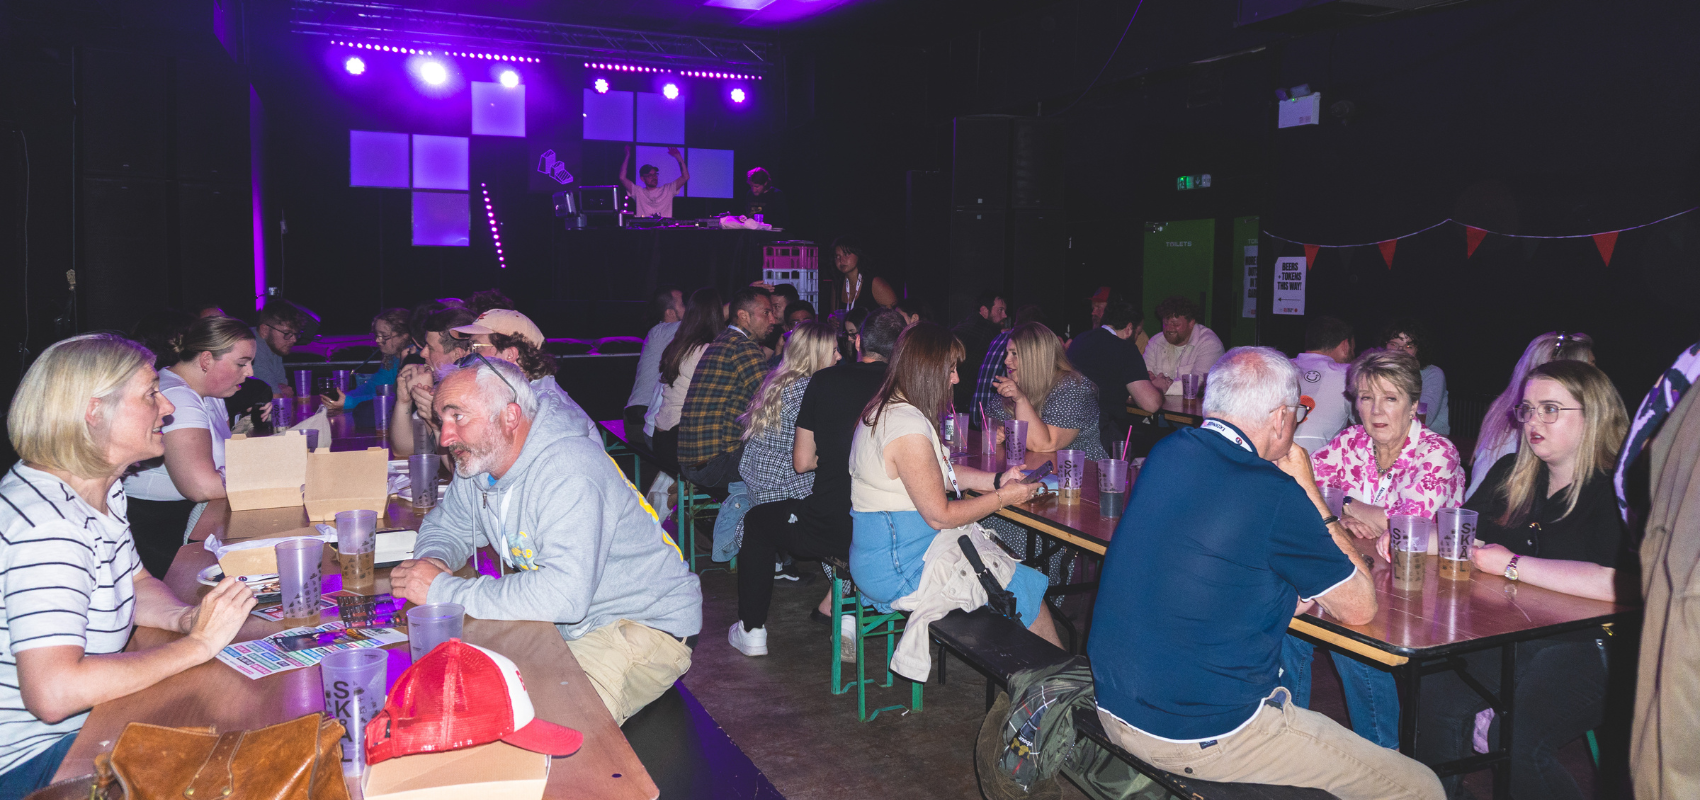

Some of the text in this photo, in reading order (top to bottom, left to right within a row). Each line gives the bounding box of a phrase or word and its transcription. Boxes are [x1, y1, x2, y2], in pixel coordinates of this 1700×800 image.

[1281, 262, 1299, 271] BEERS
[1281, 272, 1302, 281] TOKENS
[1277, 281, 1302, 291] THIS WAY!
